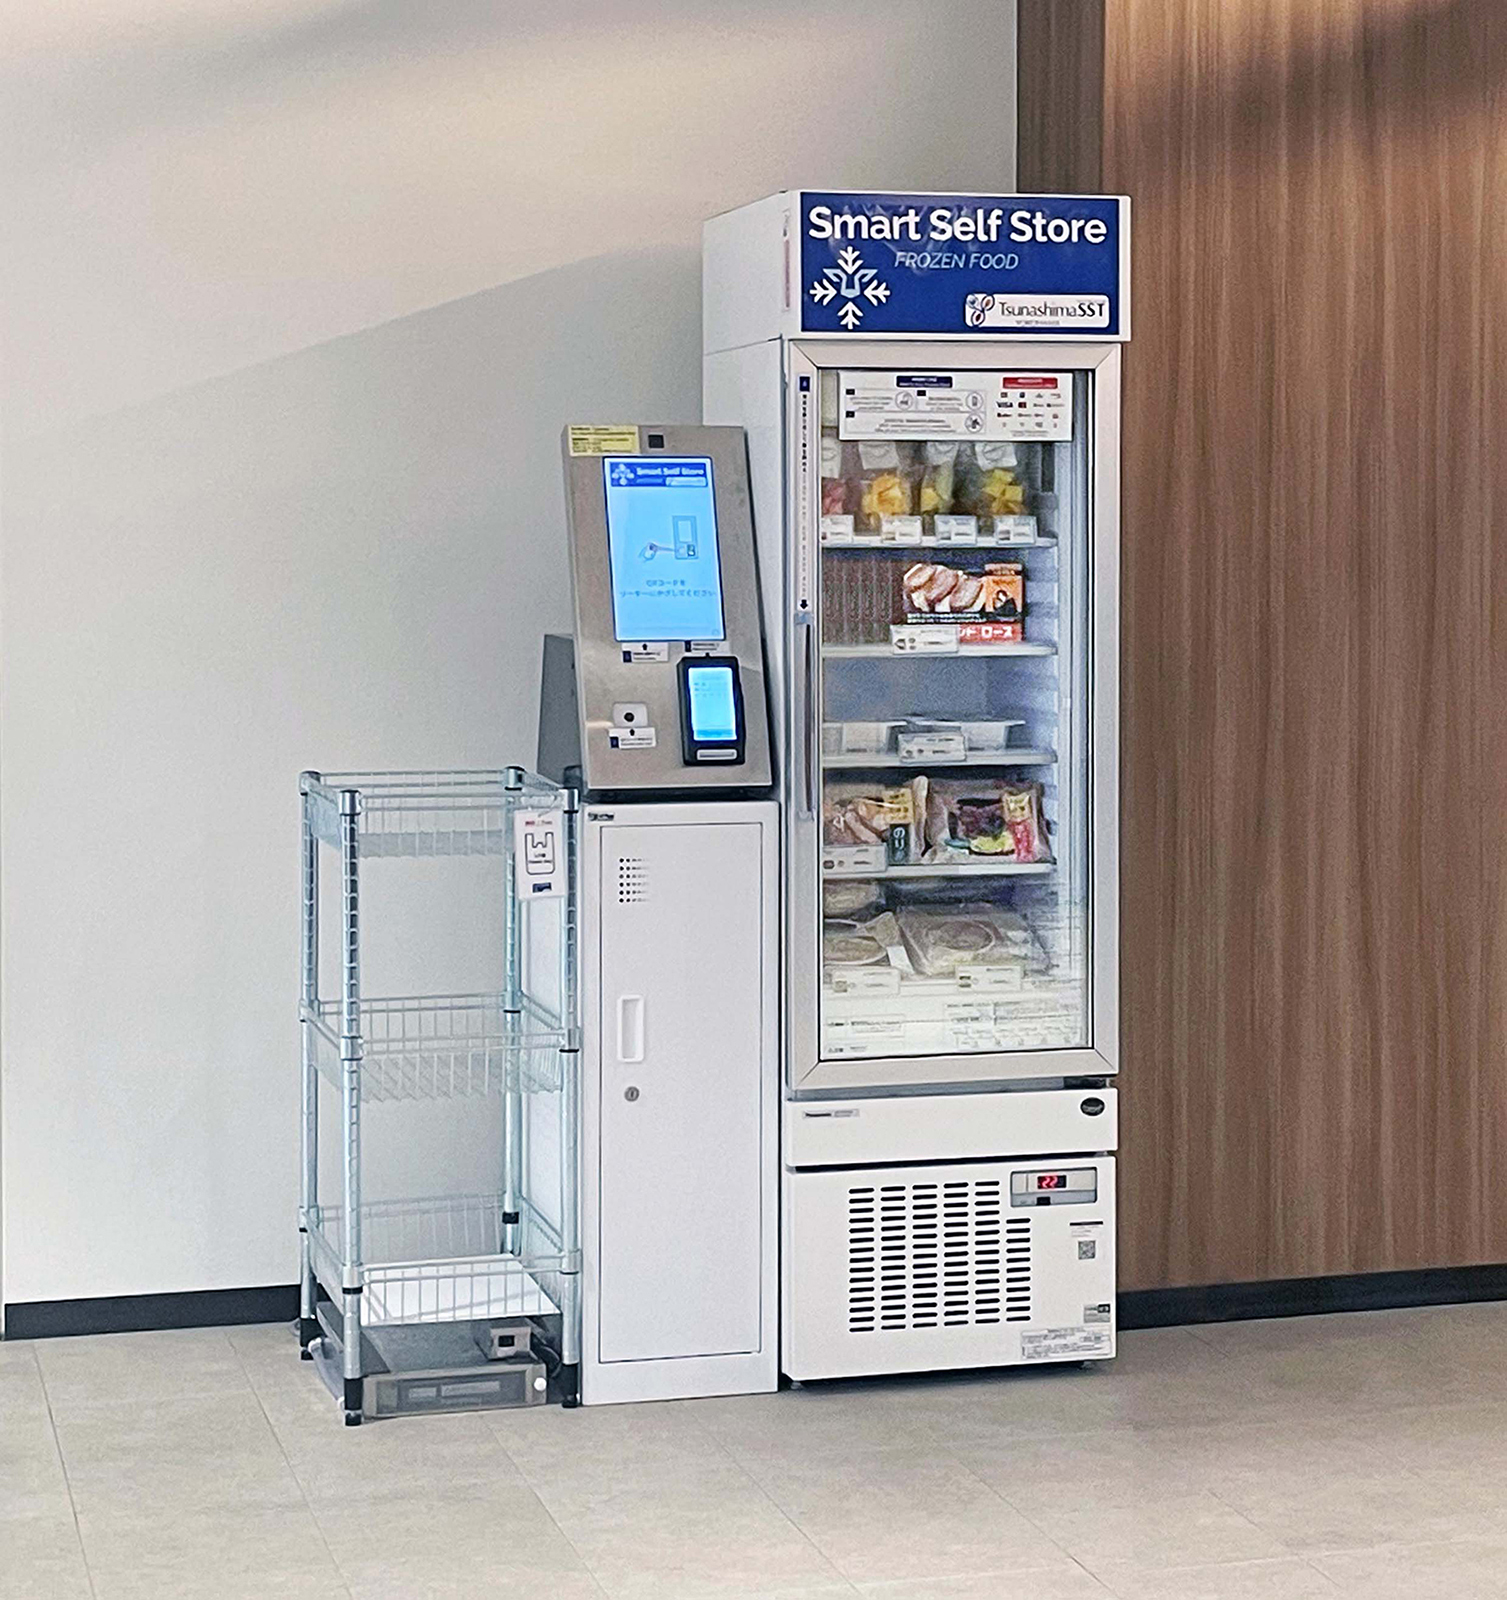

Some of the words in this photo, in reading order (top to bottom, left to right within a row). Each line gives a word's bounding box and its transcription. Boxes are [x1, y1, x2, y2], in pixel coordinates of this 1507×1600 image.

[808, 206, 921, 240] Smart
[929, 208, 1003, 242] Self
[1009, 210, 1107, 243] Store
[894, 252, 966, 269] FROZEN
[969, 253, 1019, 270] FOOD
